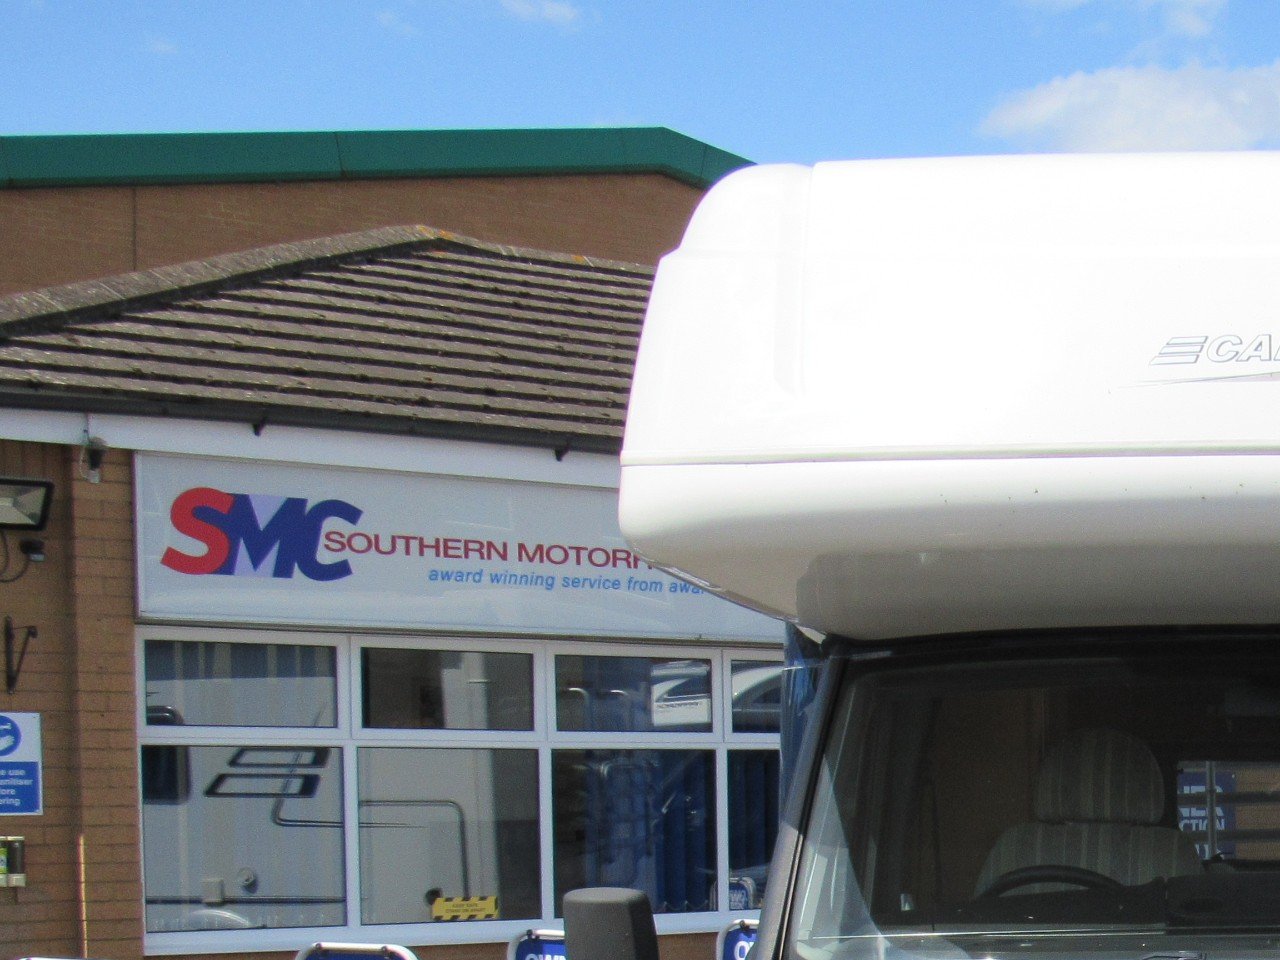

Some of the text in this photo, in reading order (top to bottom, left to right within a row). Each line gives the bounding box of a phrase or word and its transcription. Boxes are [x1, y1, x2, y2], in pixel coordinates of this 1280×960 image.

[160, 486, 364, 581] SMC
[323, 530, 508, 561] SOUTHERN
[428, 568, 483, 584] award
[489, 570, 555, 590] winning
[561, 575, 620, 590] service
[627, 575, 663, 592] from
